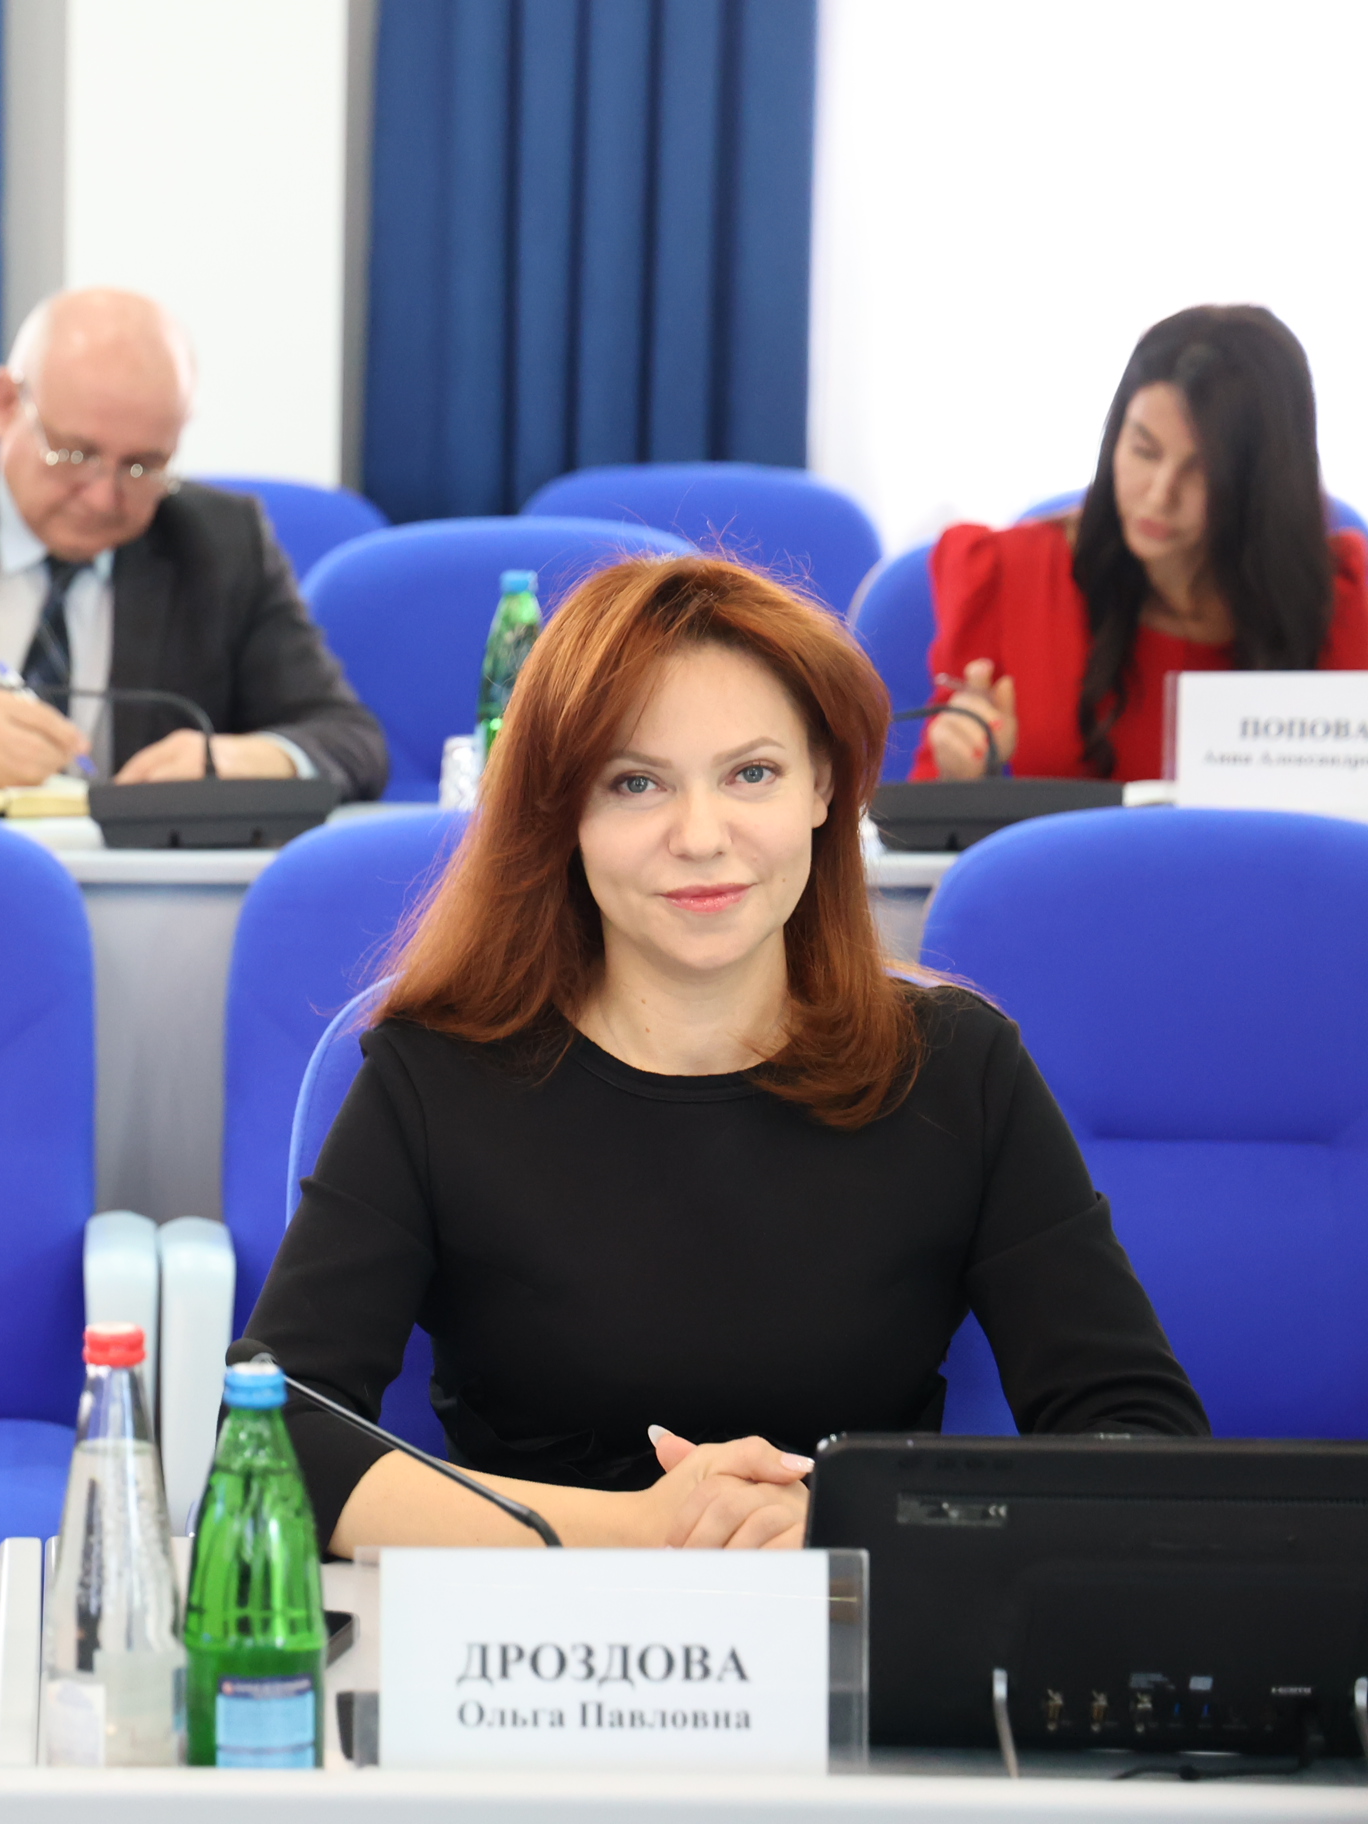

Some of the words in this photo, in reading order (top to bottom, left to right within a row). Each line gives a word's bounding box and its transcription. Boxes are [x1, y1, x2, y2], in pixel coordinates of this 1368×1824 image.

[456, 1643, 751, 1688] ДРОЗДОВА
[457, 1700, 566, 1730] Ольга
[579, 1700, 753, 1731] Павловна
